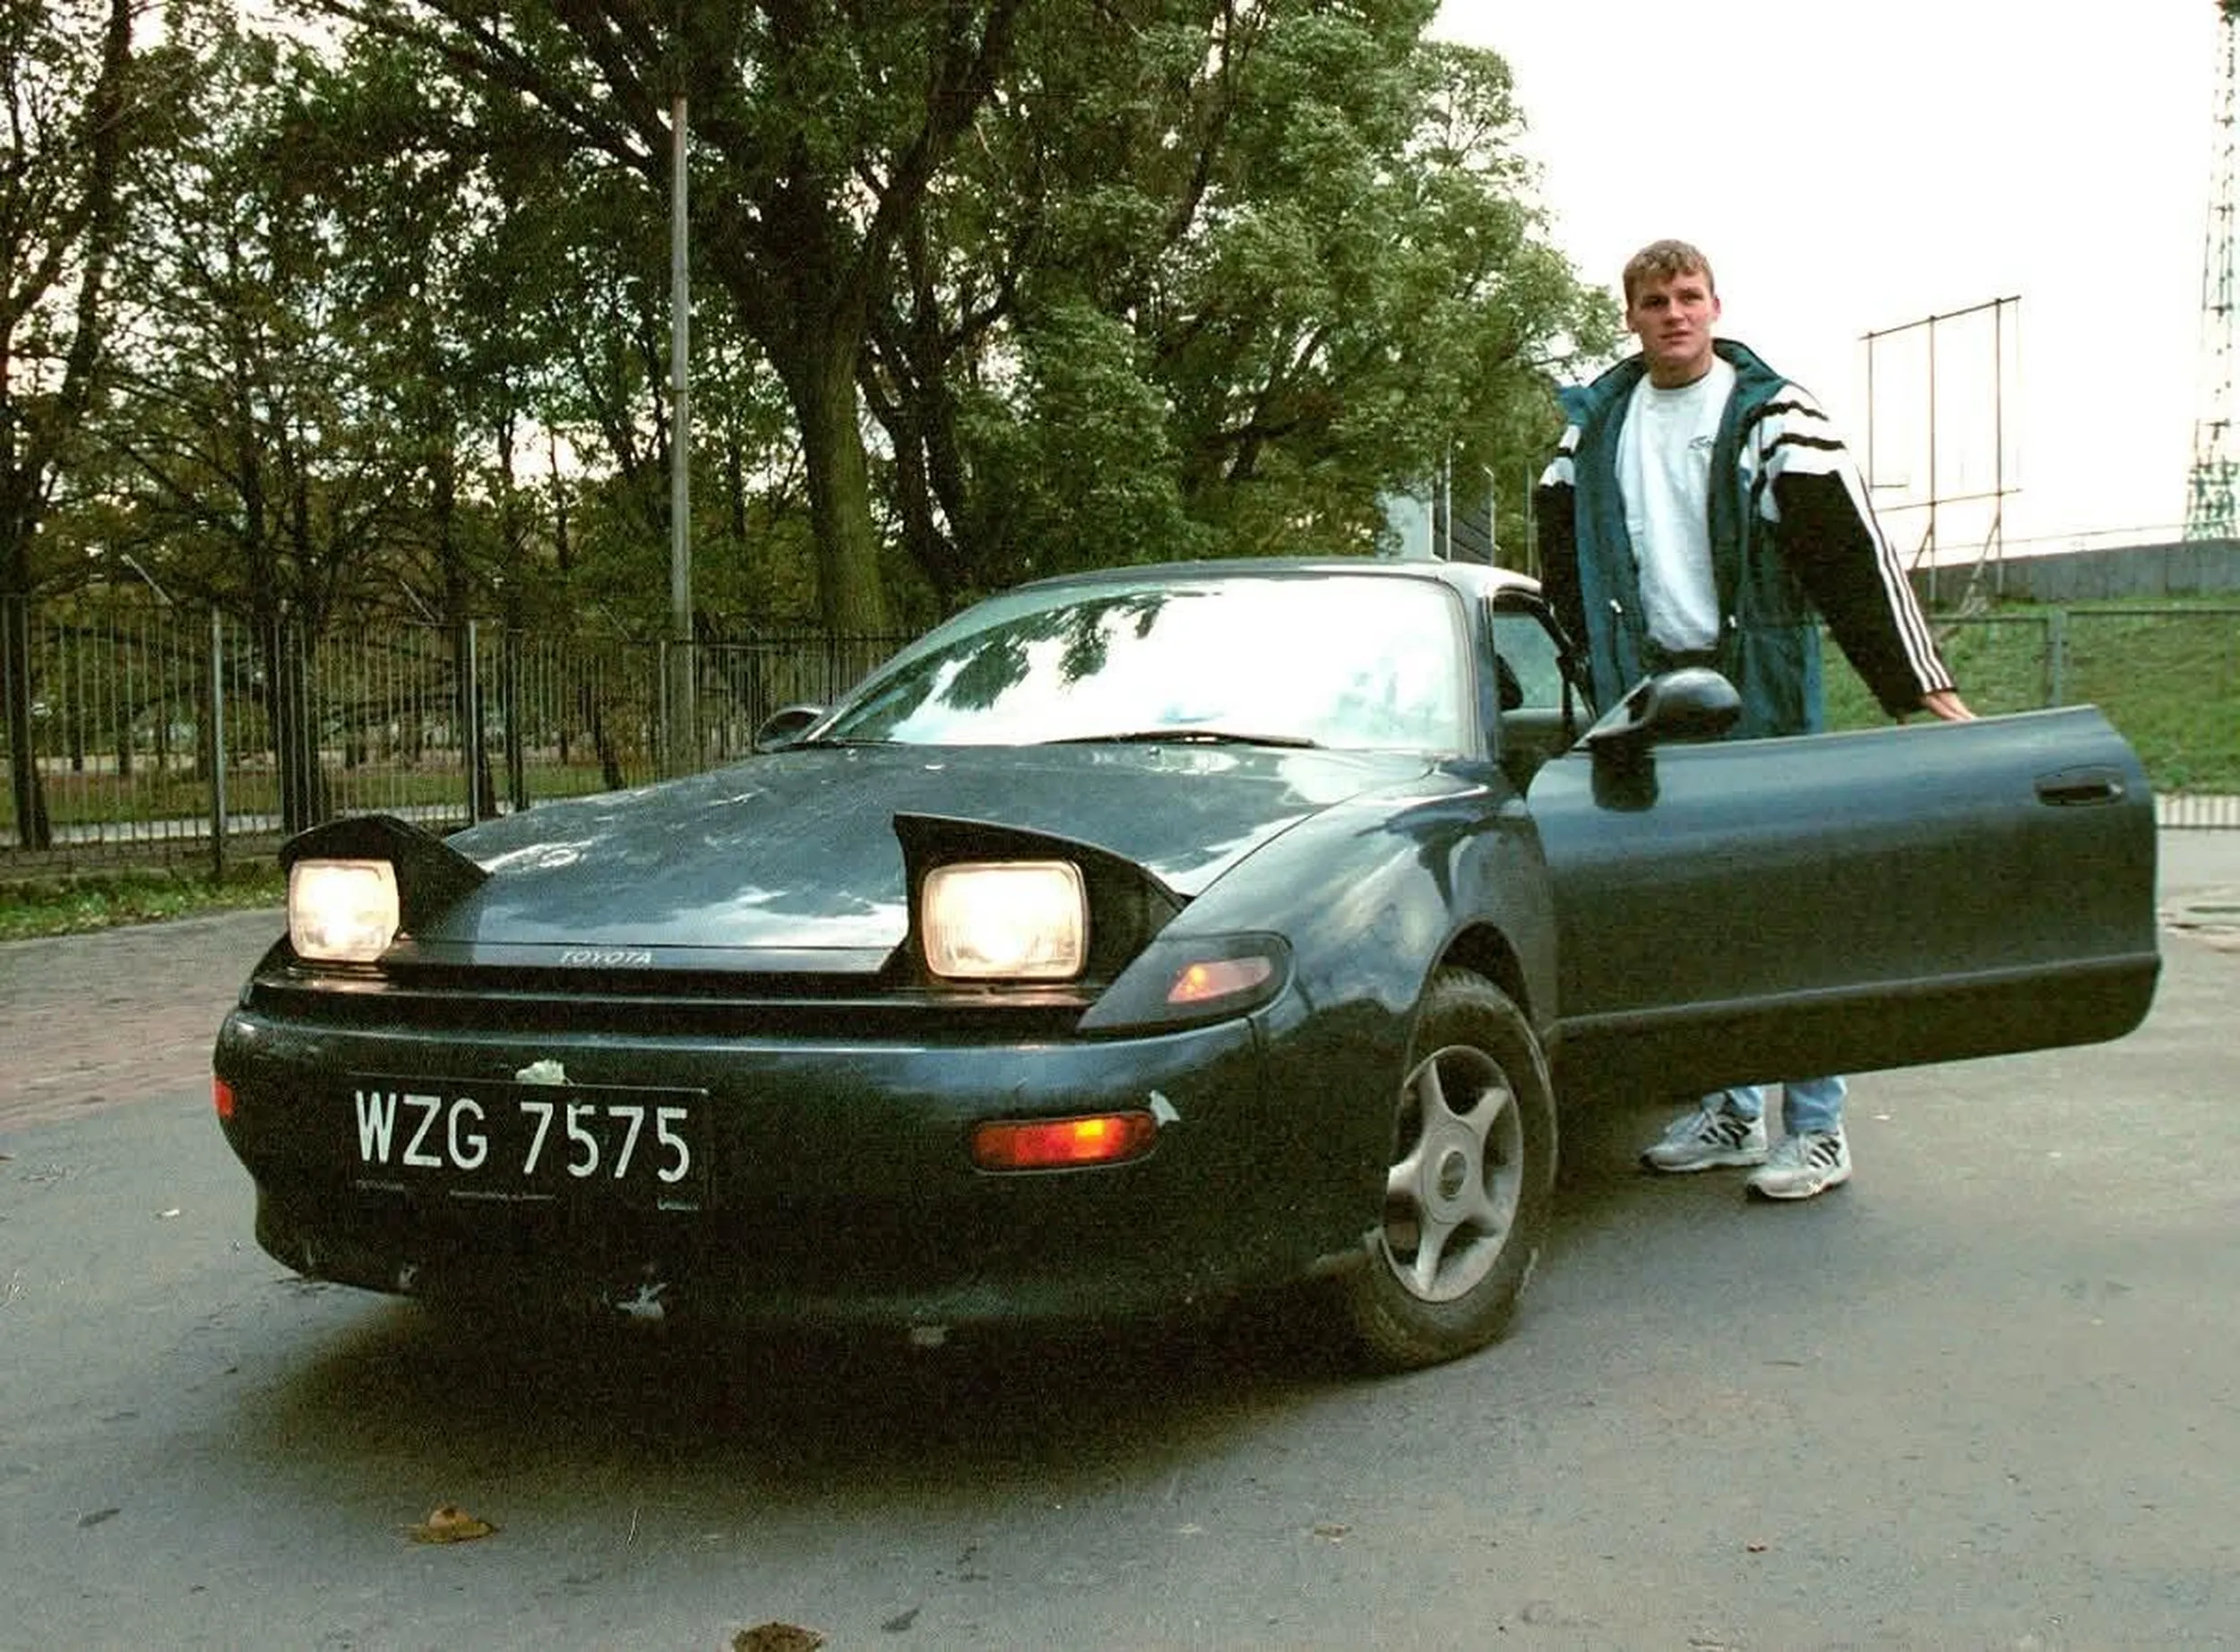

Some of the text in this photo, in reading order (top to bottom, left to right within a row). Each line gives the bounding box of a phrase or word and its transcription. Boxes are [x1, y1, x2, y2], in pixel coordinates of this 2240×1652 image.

[559, 950, 653, 967] TOYOTA
[356, 1089, 691, 1183] WZG 7575
